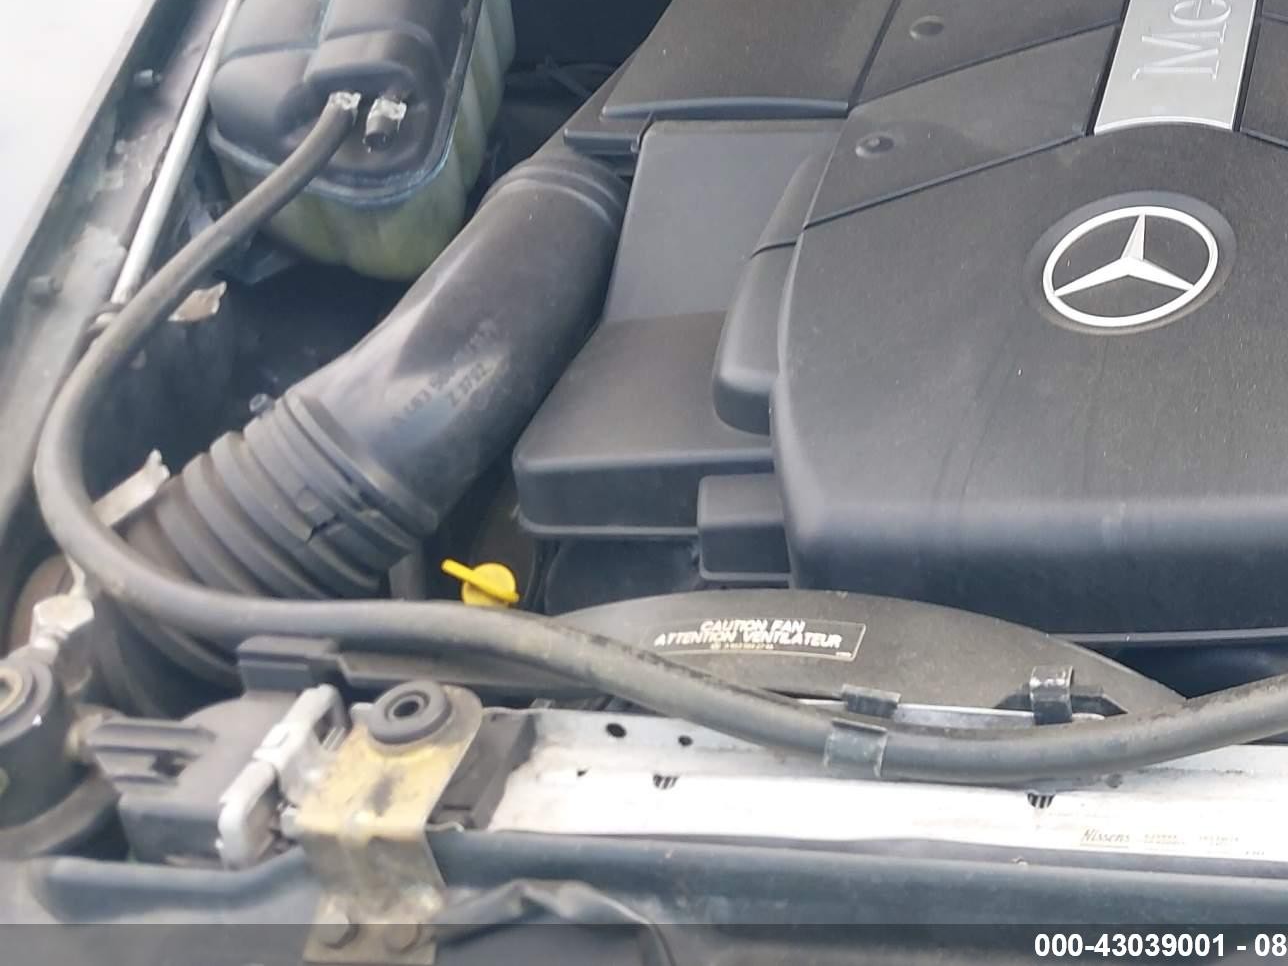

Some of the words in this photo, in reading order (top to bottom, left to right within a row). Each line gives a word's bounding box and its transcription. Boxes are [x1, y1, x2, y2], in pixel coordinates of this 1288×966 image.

[700, 619, 768, 633] CAUTION
[771, 619, 805, 633] FAN
[654, 631, 736, 646] ATTENTION
[742, 631, 842, 648] VENTILATEUR
[1081, 828, 1130, 843] Nissens
